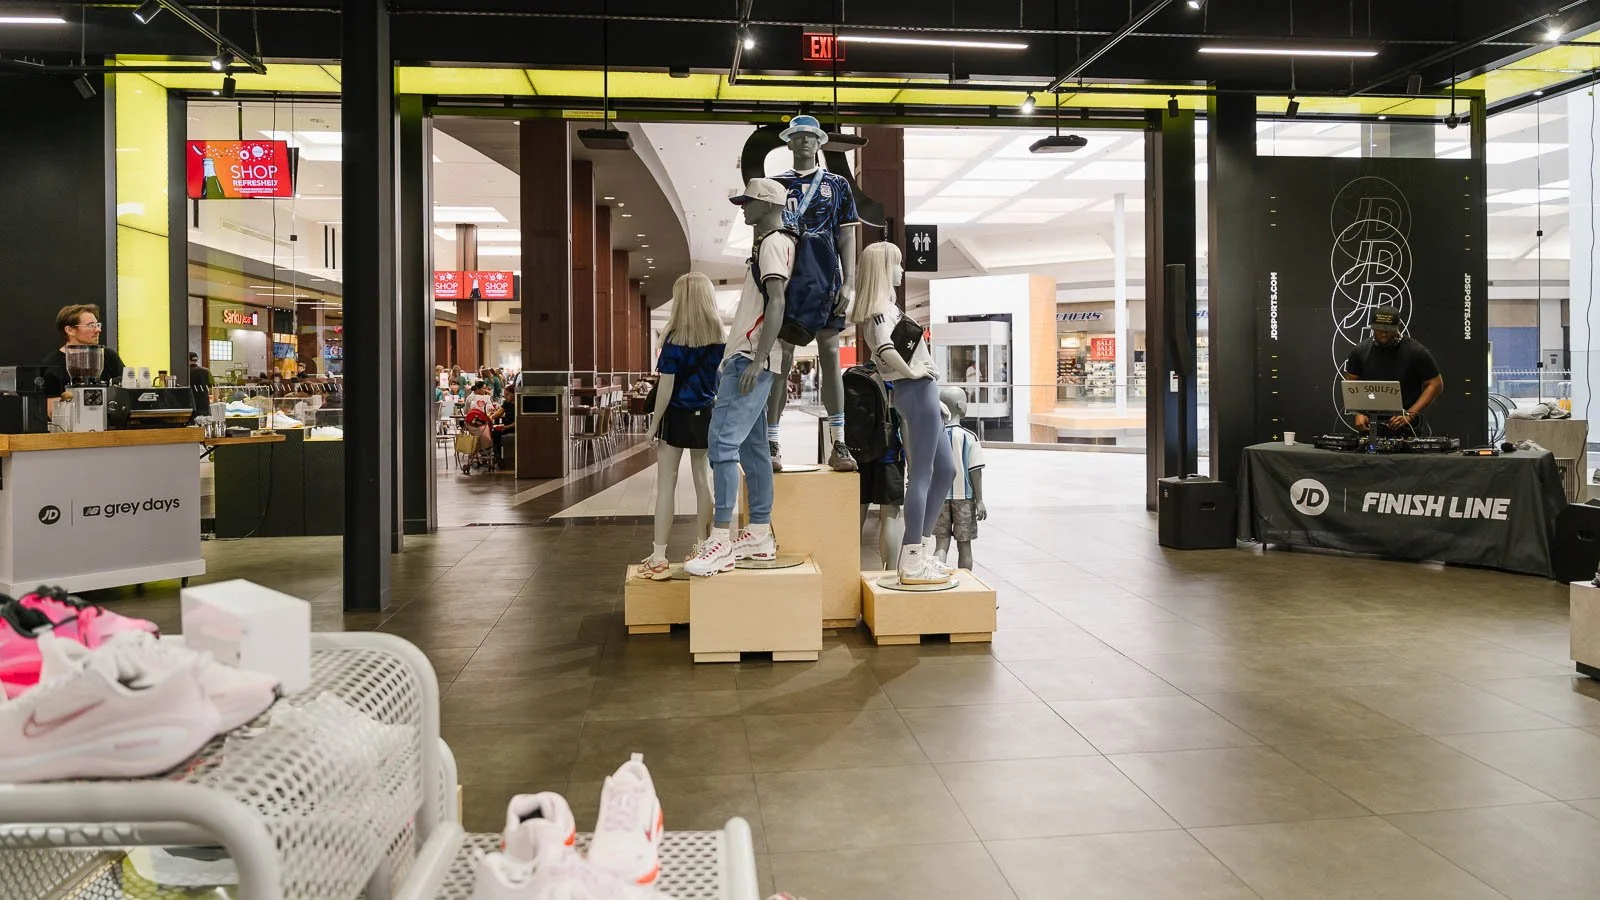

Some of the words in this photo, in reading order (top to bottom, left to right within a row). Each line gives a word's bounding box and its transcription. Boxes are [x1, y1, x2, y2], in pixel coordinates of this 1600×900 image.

[230, 164, 278, 179] SHOP
[232, 179, 278, 187] REFRESHED
[1342, 197, 1402, 242] JD
[1342, 240, 1402, 286] JD
[434, 282, 458, 290] SHOP
[485, 282, 508, 290] SHOP
[1270, 272, 1278, 341] JDSPORTS.COM
[223, 309, 242, 324] Sarku
[1347, 386, 1359, 394] DJ
[1363, 385, 1400, 395] SOULFLY
[104, 501, 140, 518] grey
[142, 498, 180, 512] days
[1362, 491, 1446, 518] FINISH
[1449, 496, 1511, 521] LINE
